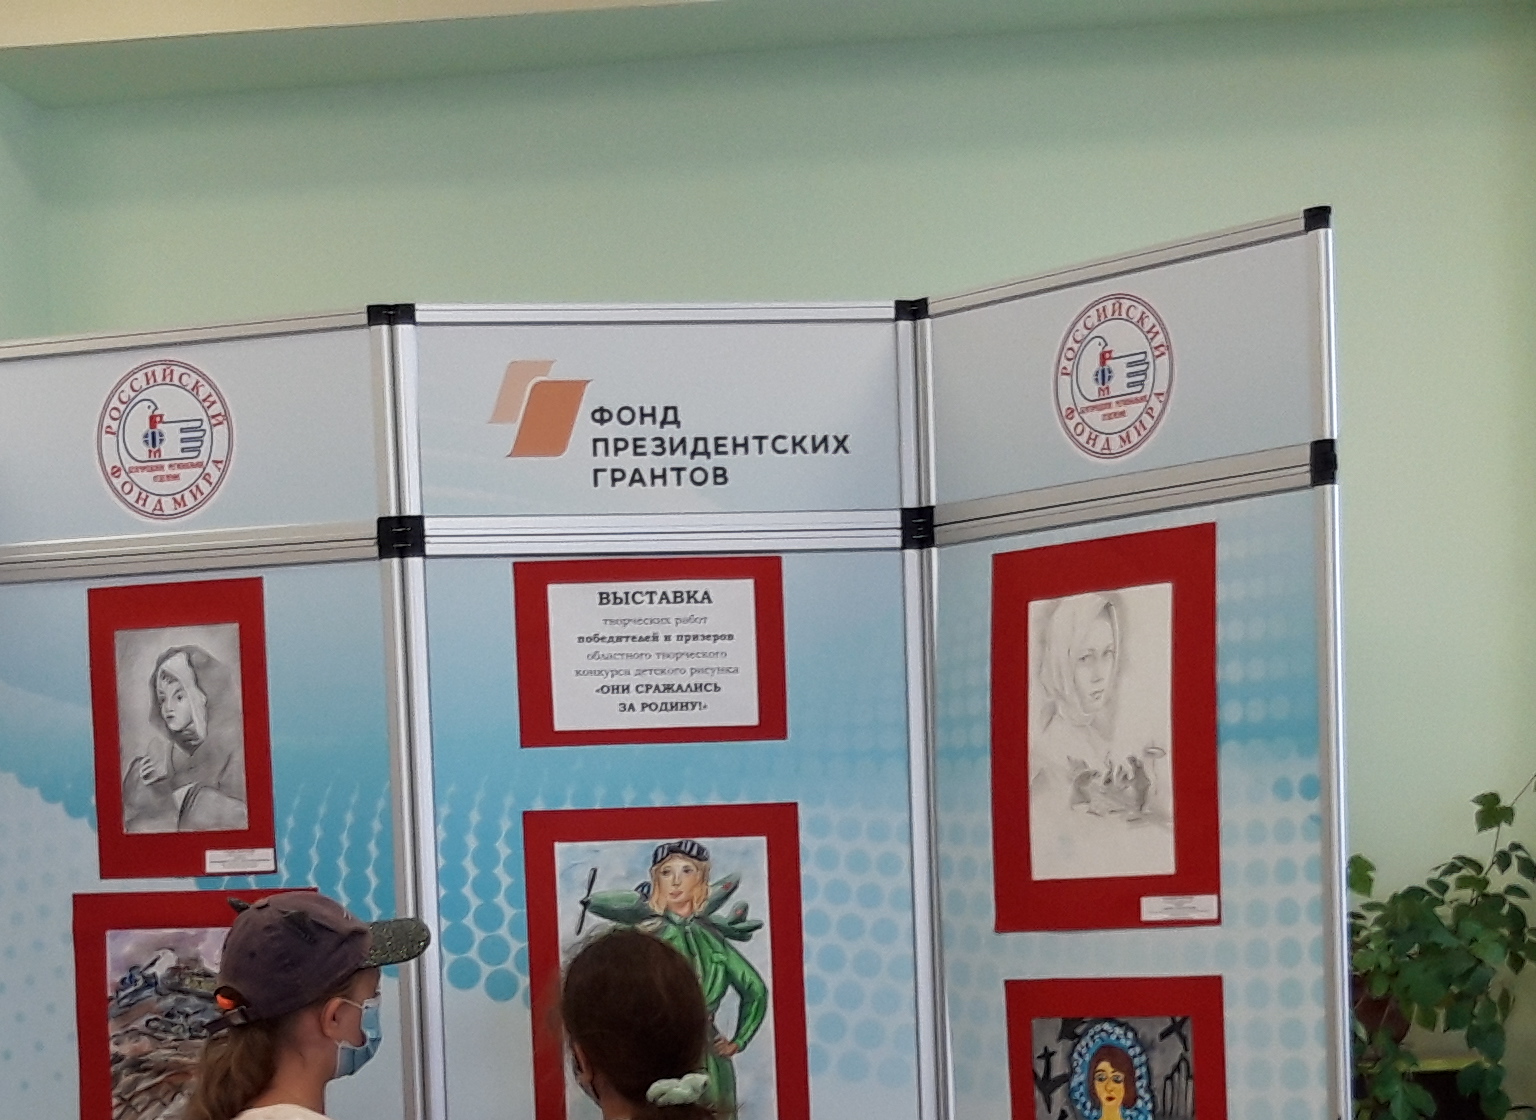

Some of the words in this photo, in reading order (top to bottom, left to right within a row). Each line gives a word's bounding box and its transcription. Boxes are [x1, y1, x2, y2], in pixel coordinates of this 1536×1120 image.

[1061, 300, 1169, 377] РОССИЙСКИЙ
[105, 366, 227, 437] РОССИЙСКИЙ
[590, 405, 681, 429] ФОНД
[1064, 406, 1112, 453] ФОНД
[1119, 391, 1165, 449] МИРА
[592, 434, 850, 460] ПРЕЗИДЕНТСКИХ
[109, 464, 165, 513] ФОНД
[172, 459, 224, 511] МИРА
[592, 466, 729, 488] ГРАНТОВ
[597, 590, 713, 606] ВЫСТАВКА
[602, 616, 670, 628] творческих
[674, 614, 708, 627] работ
[577, 632, 659, 644] победителей
[664, 634, 672, 642] и
[587, 650, 652, 661] областного
[656, 649, 727, 662] творческого
[575, 667, 630, 680] конкурса
[634, 665, 686, 678] детского
[690, 665, 739, 678] рисунка
[635, 682, 721, 695] СРАЖАЛИСЬ
[619, 702, 635, 713] ЗА
